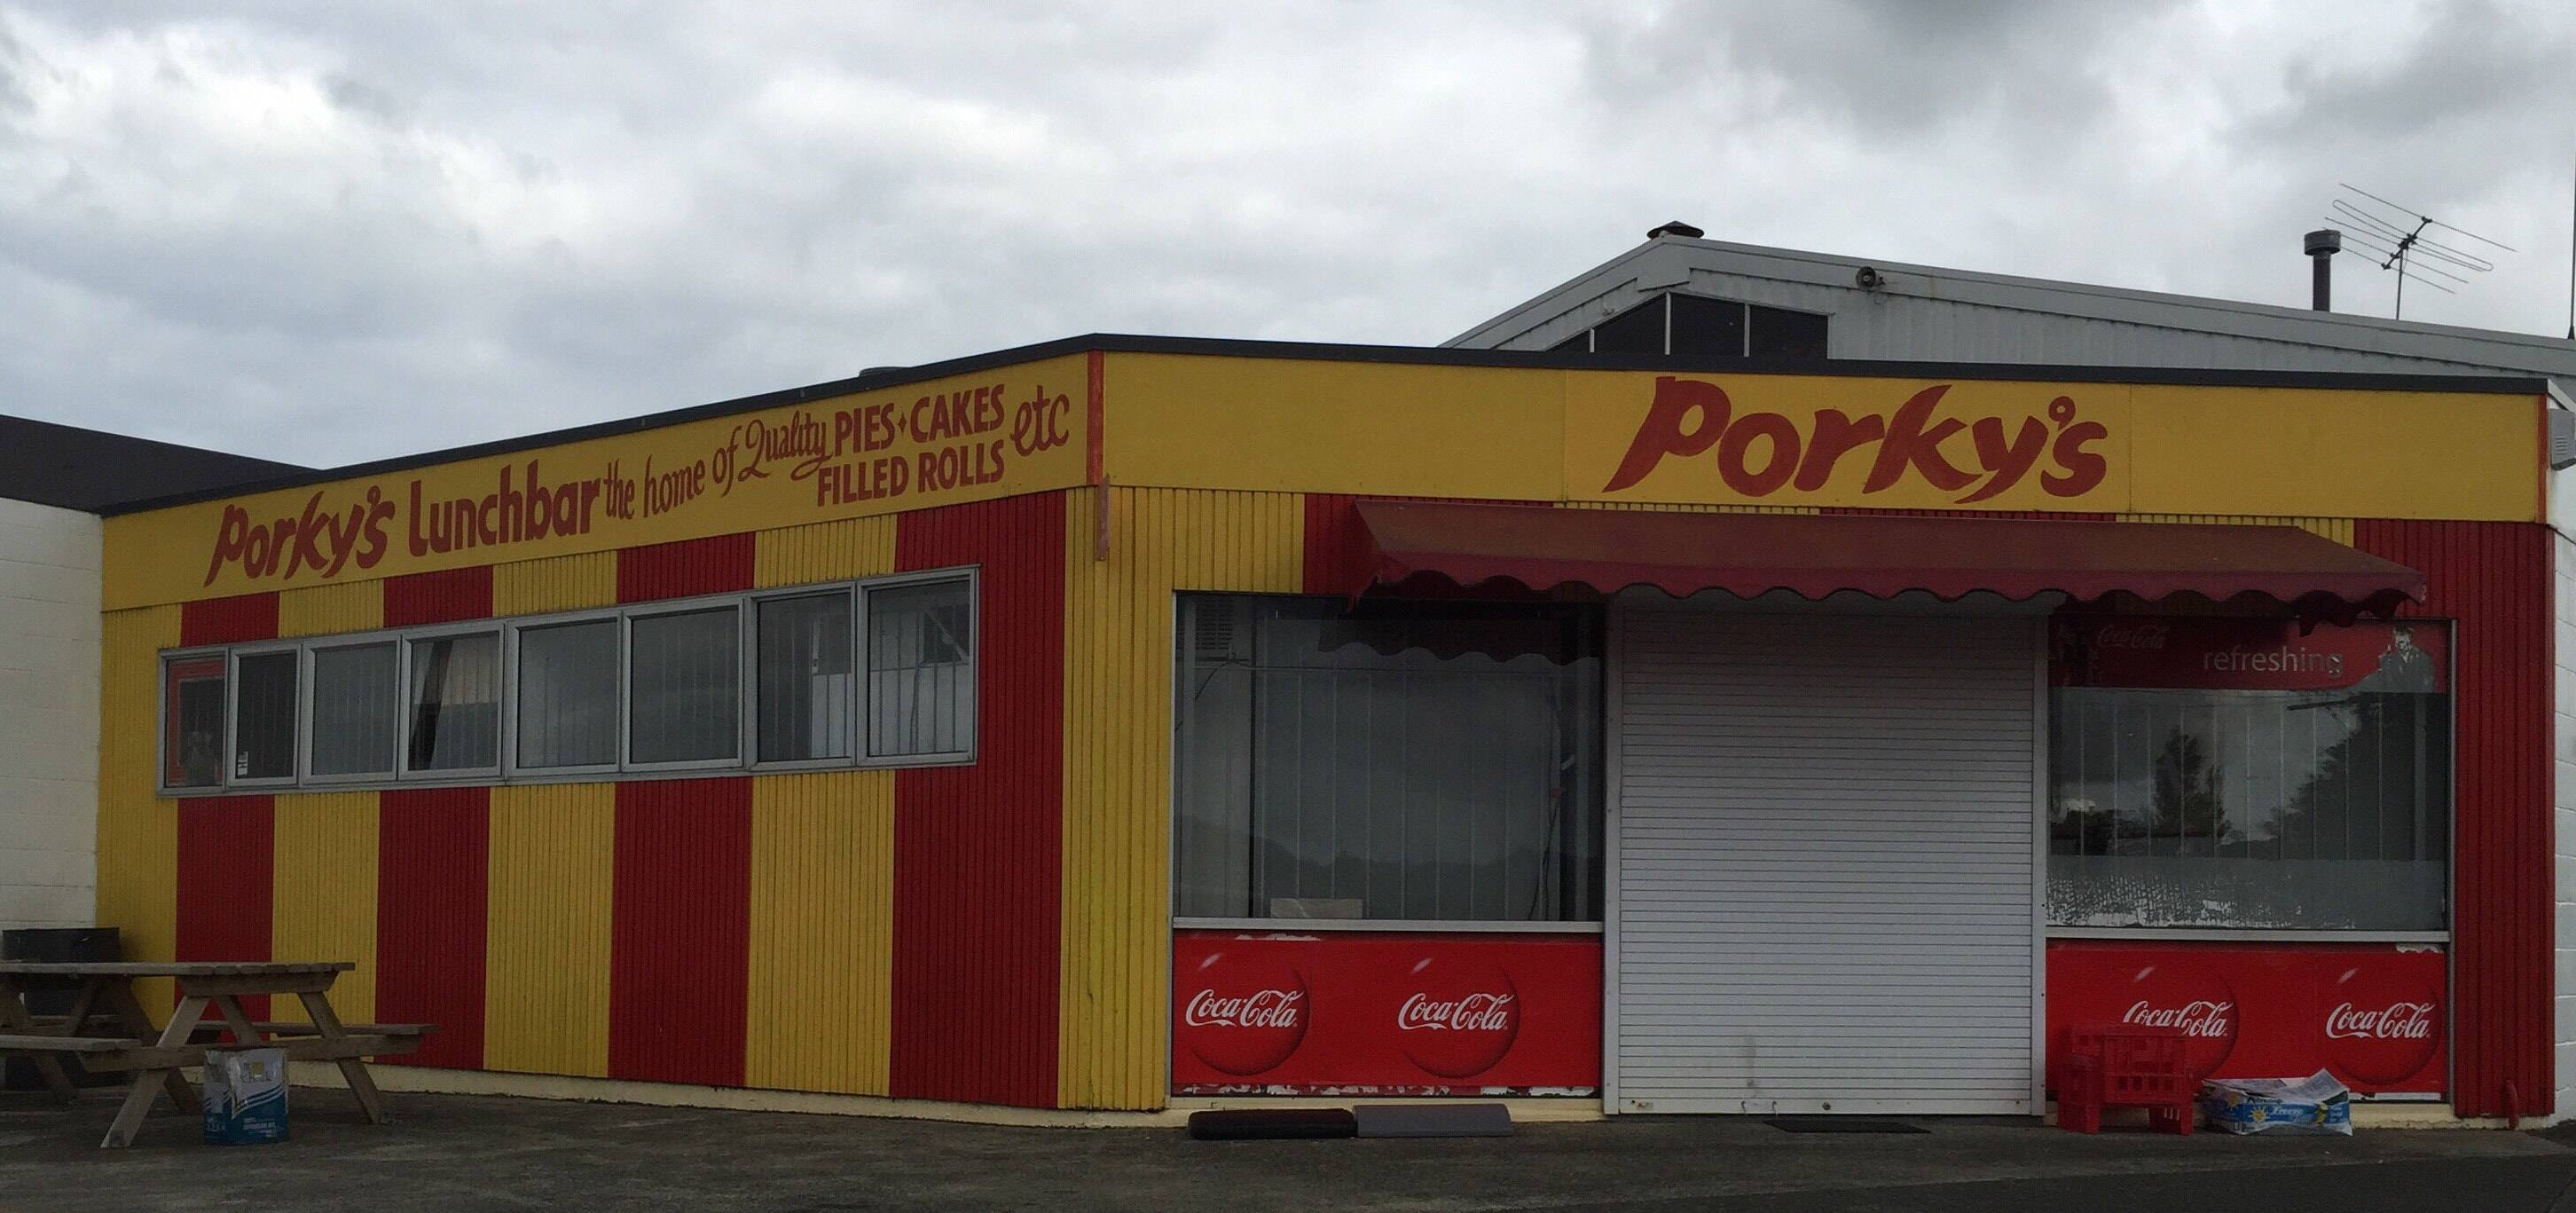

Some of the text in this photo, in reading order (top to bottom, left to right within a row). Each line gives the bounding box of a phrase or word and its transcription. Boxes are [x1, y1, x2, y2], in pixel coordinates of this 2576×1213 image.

[835, 384, 1005, 457] PIES CAKES
[1009, 385, 1070, 457] etc
[1601, 375, 2109, 504] Porky's
[603, 411, 833, 519] the home of Quality
[818, 439, 1005, 507] FILLED ROLLS
[203, 459, 601, 587] Porky's Lunchbar
[2203, 645, 2343, 678] refreshing
[1185, 989, 1304, 1028] Coca-Cola
[1398, 993, 1515, 1030] Coca-Cola
[2326, 1002, 2436, 1039] Coca-Cola
